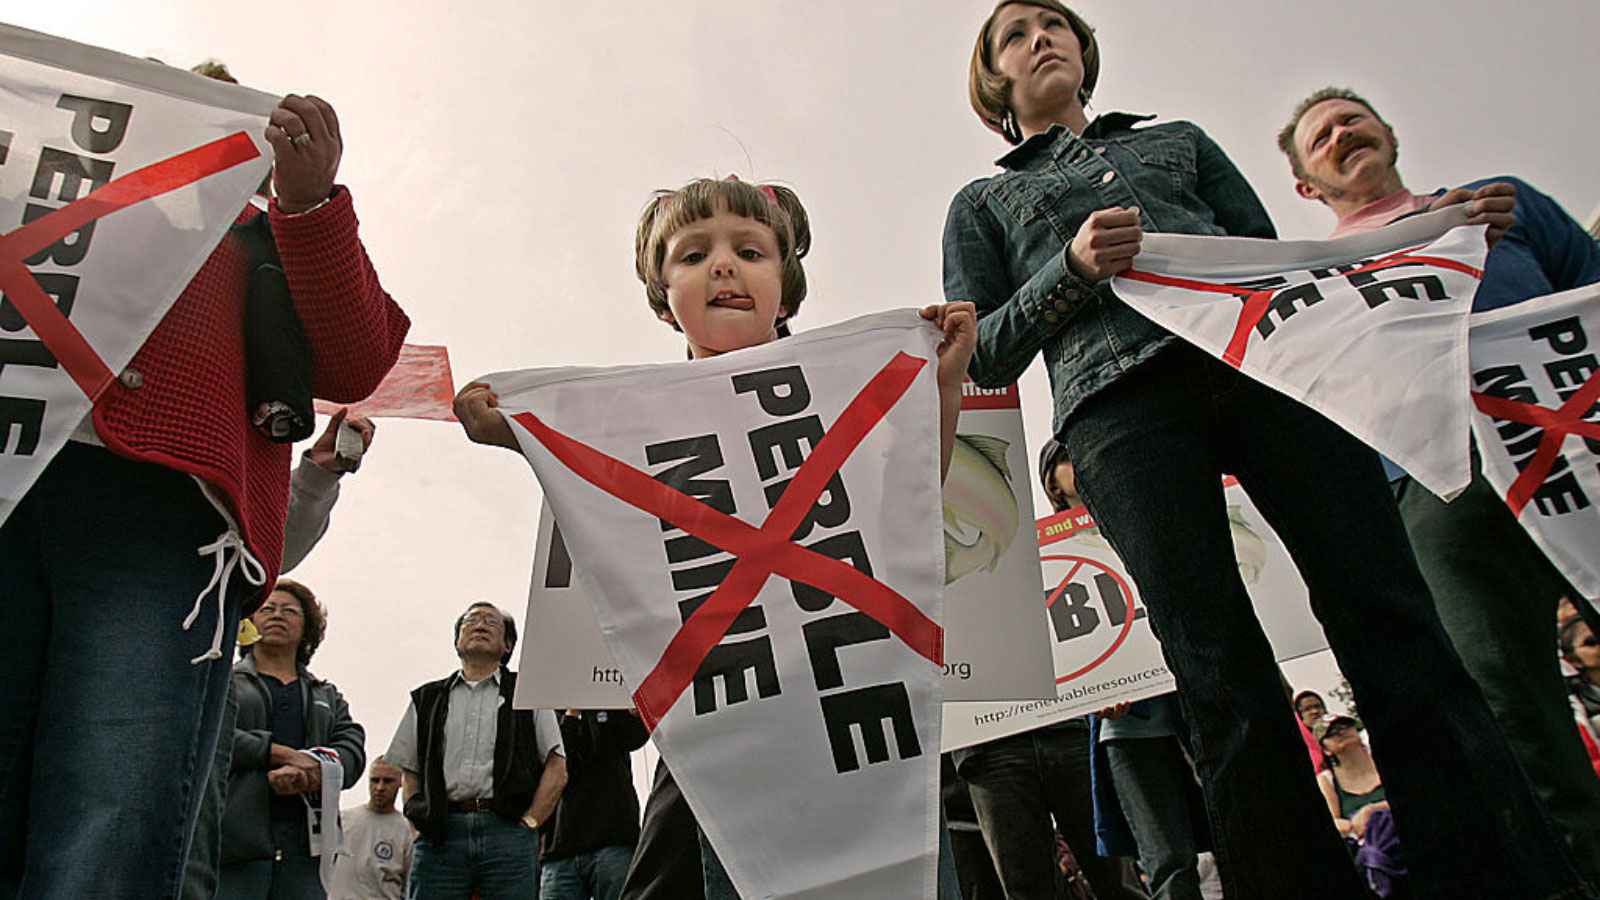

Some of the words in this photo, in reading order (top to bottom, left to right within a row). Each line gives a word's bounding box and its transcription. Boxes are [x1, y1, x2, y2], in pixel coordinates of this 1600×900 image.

[645, 433, 782, 716] MINE
[731, 365, 922, 774] PEBBLE
[1045, 518, 1073, 536] and
